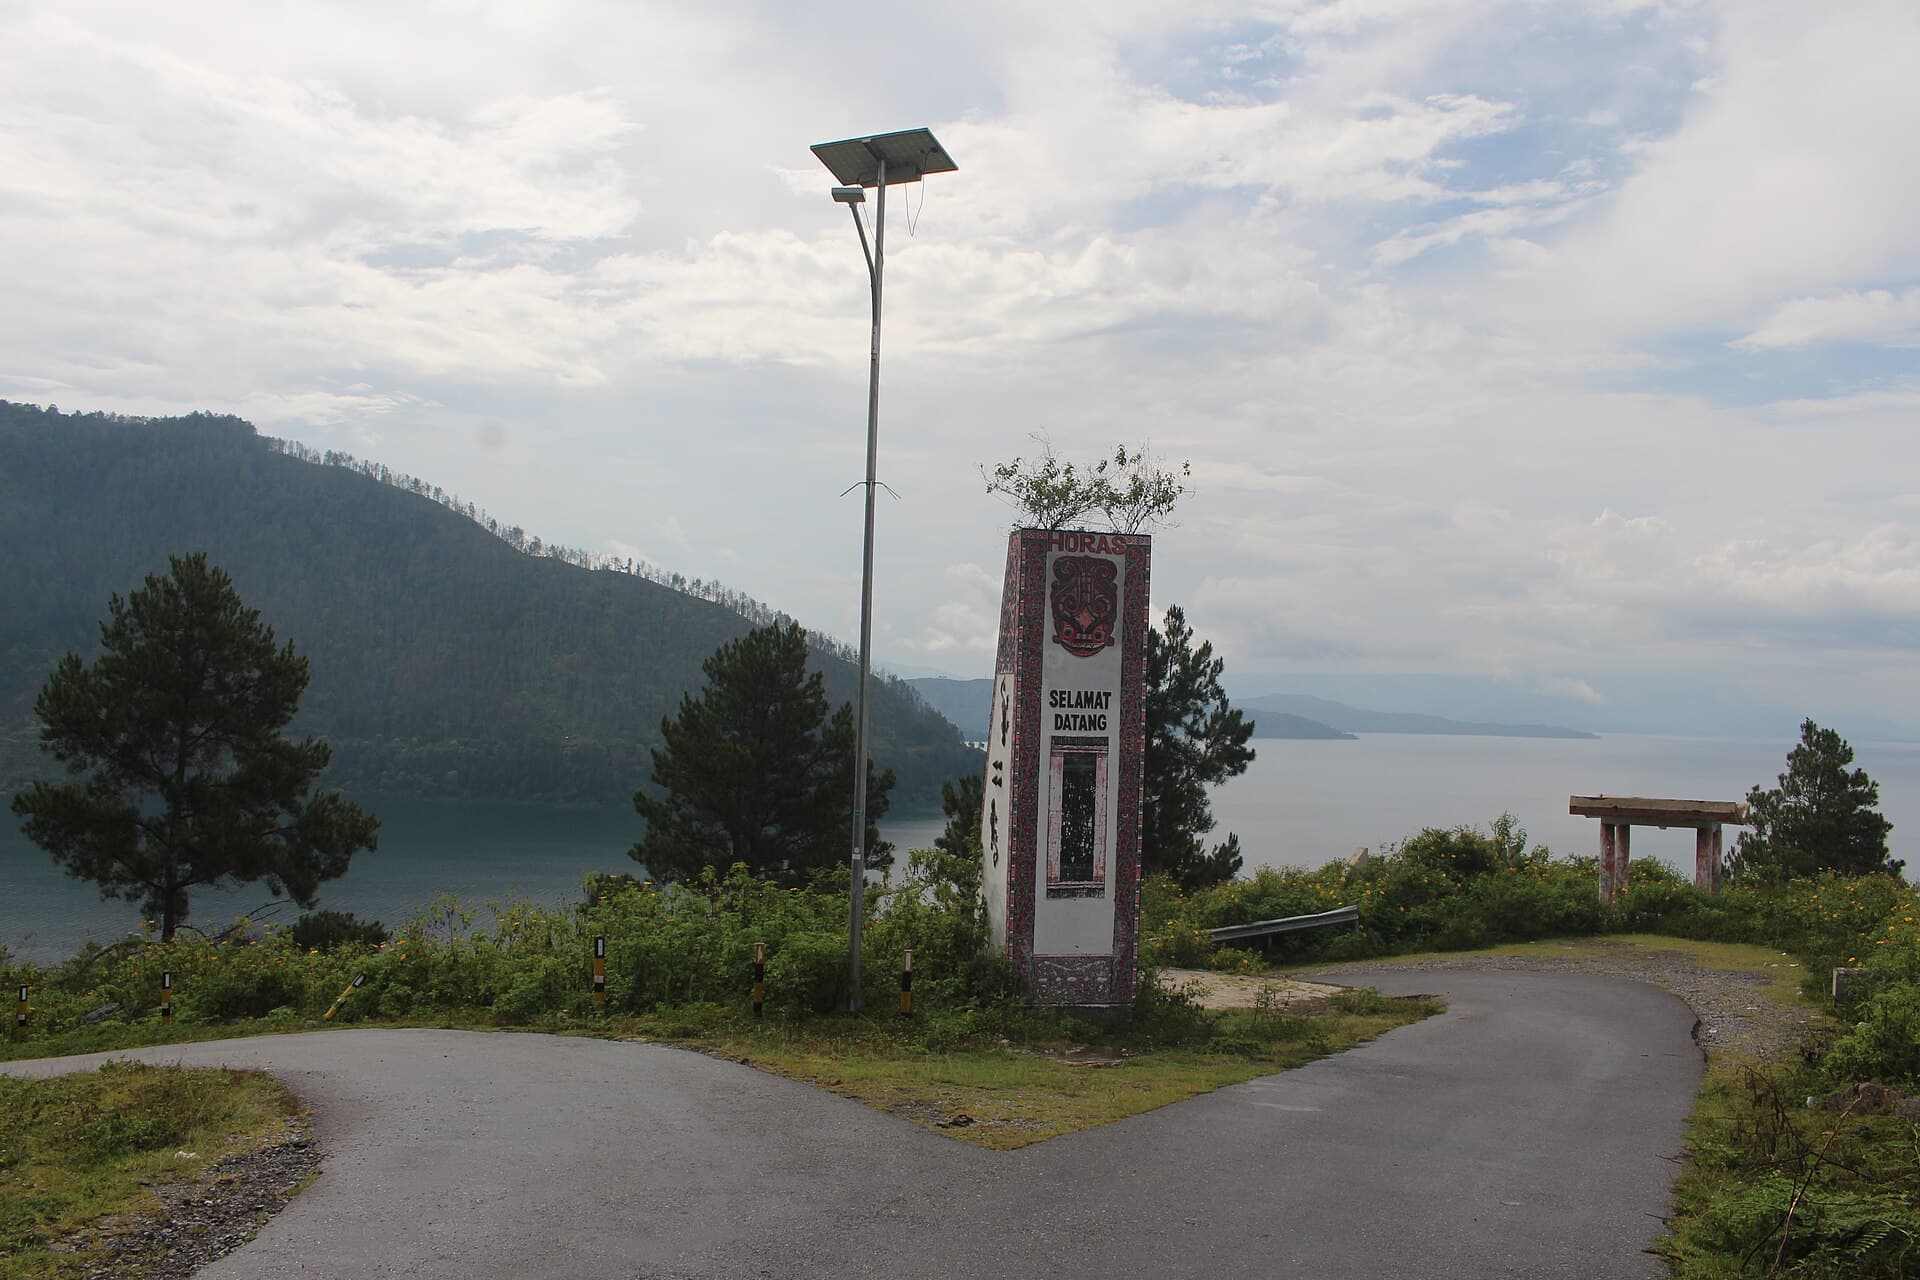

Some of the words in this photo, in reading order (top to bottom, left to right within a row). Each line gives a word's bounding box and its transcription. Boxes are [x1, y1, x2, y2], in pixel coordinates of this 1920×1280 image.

[1047, 532, 1126, 555] HORAS
[1049, 690, 1111, 709] SELAMAT
[1054, 714, 1107, 731] DATANG
